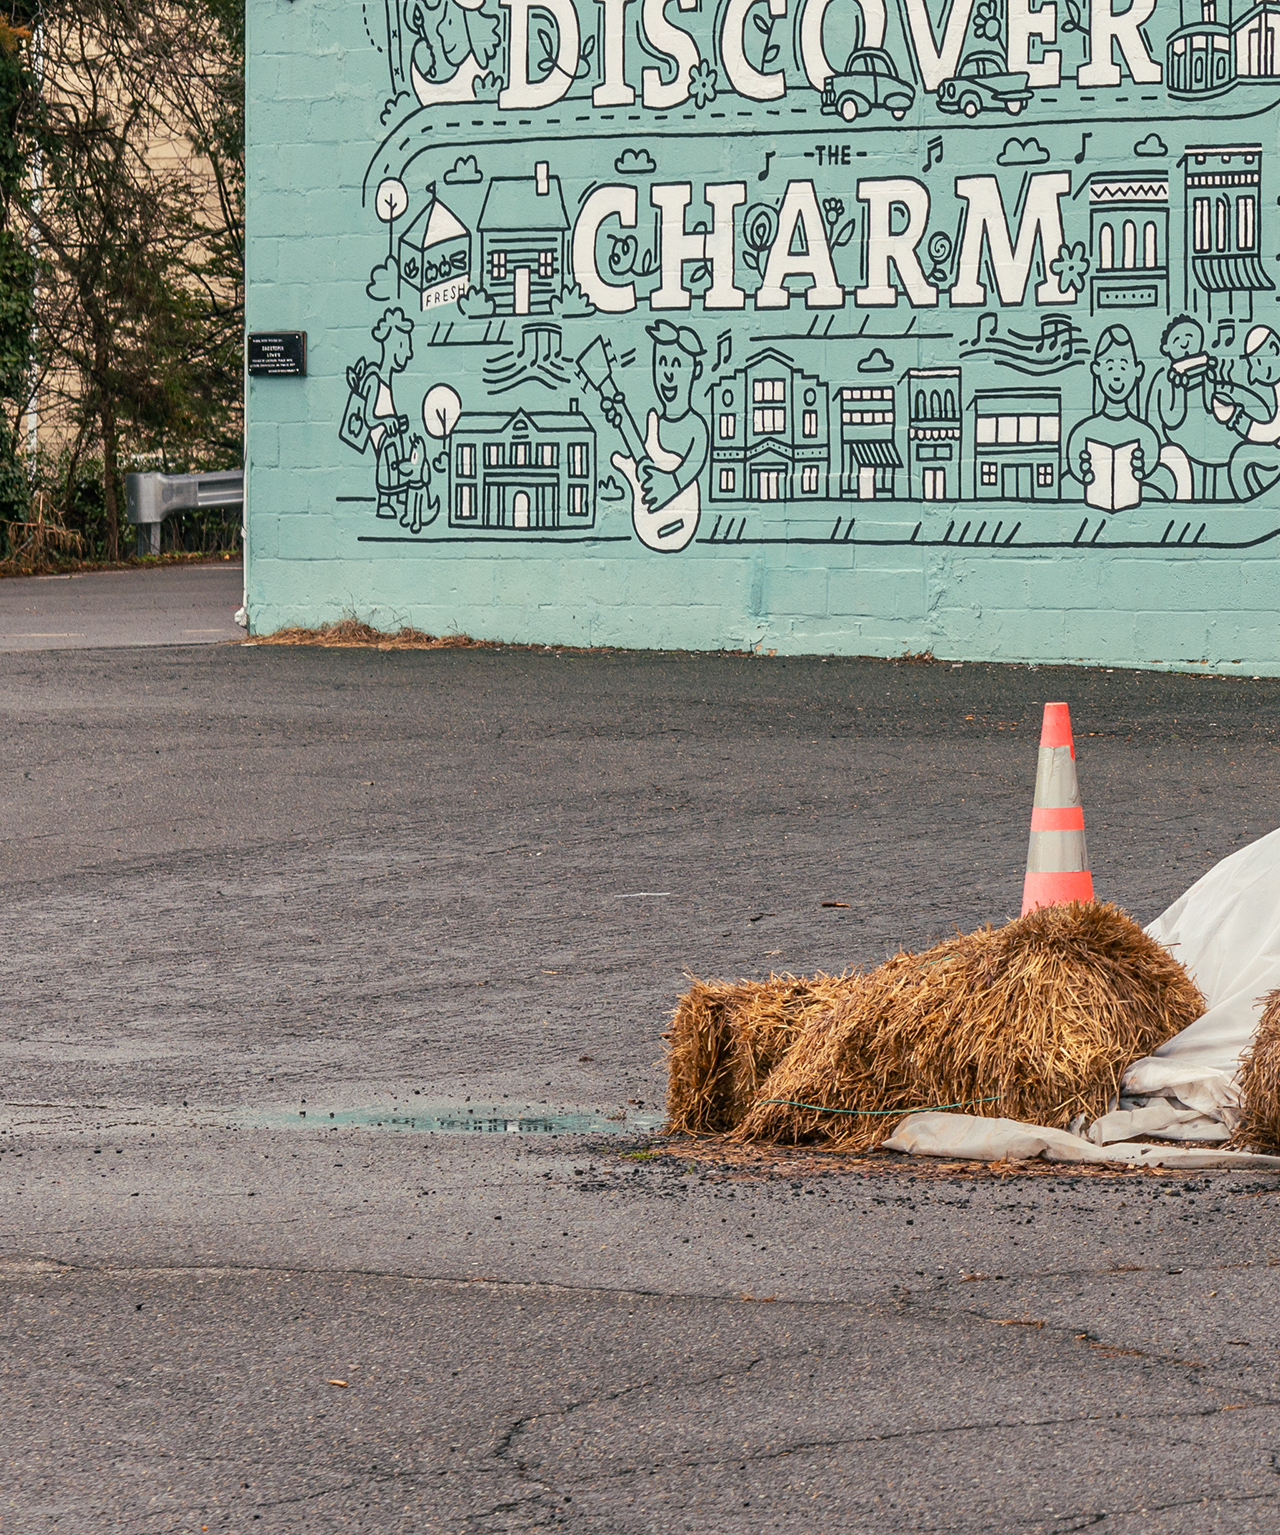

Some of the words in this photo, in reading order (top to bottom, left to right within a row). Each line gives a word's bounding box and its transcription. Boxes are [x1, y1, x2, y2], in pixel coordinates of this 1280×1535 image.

[815, 145, 851, 166] THE
[572, 170, 1077, 314] CHARM
[426, 283, 466, 307] FRESH
